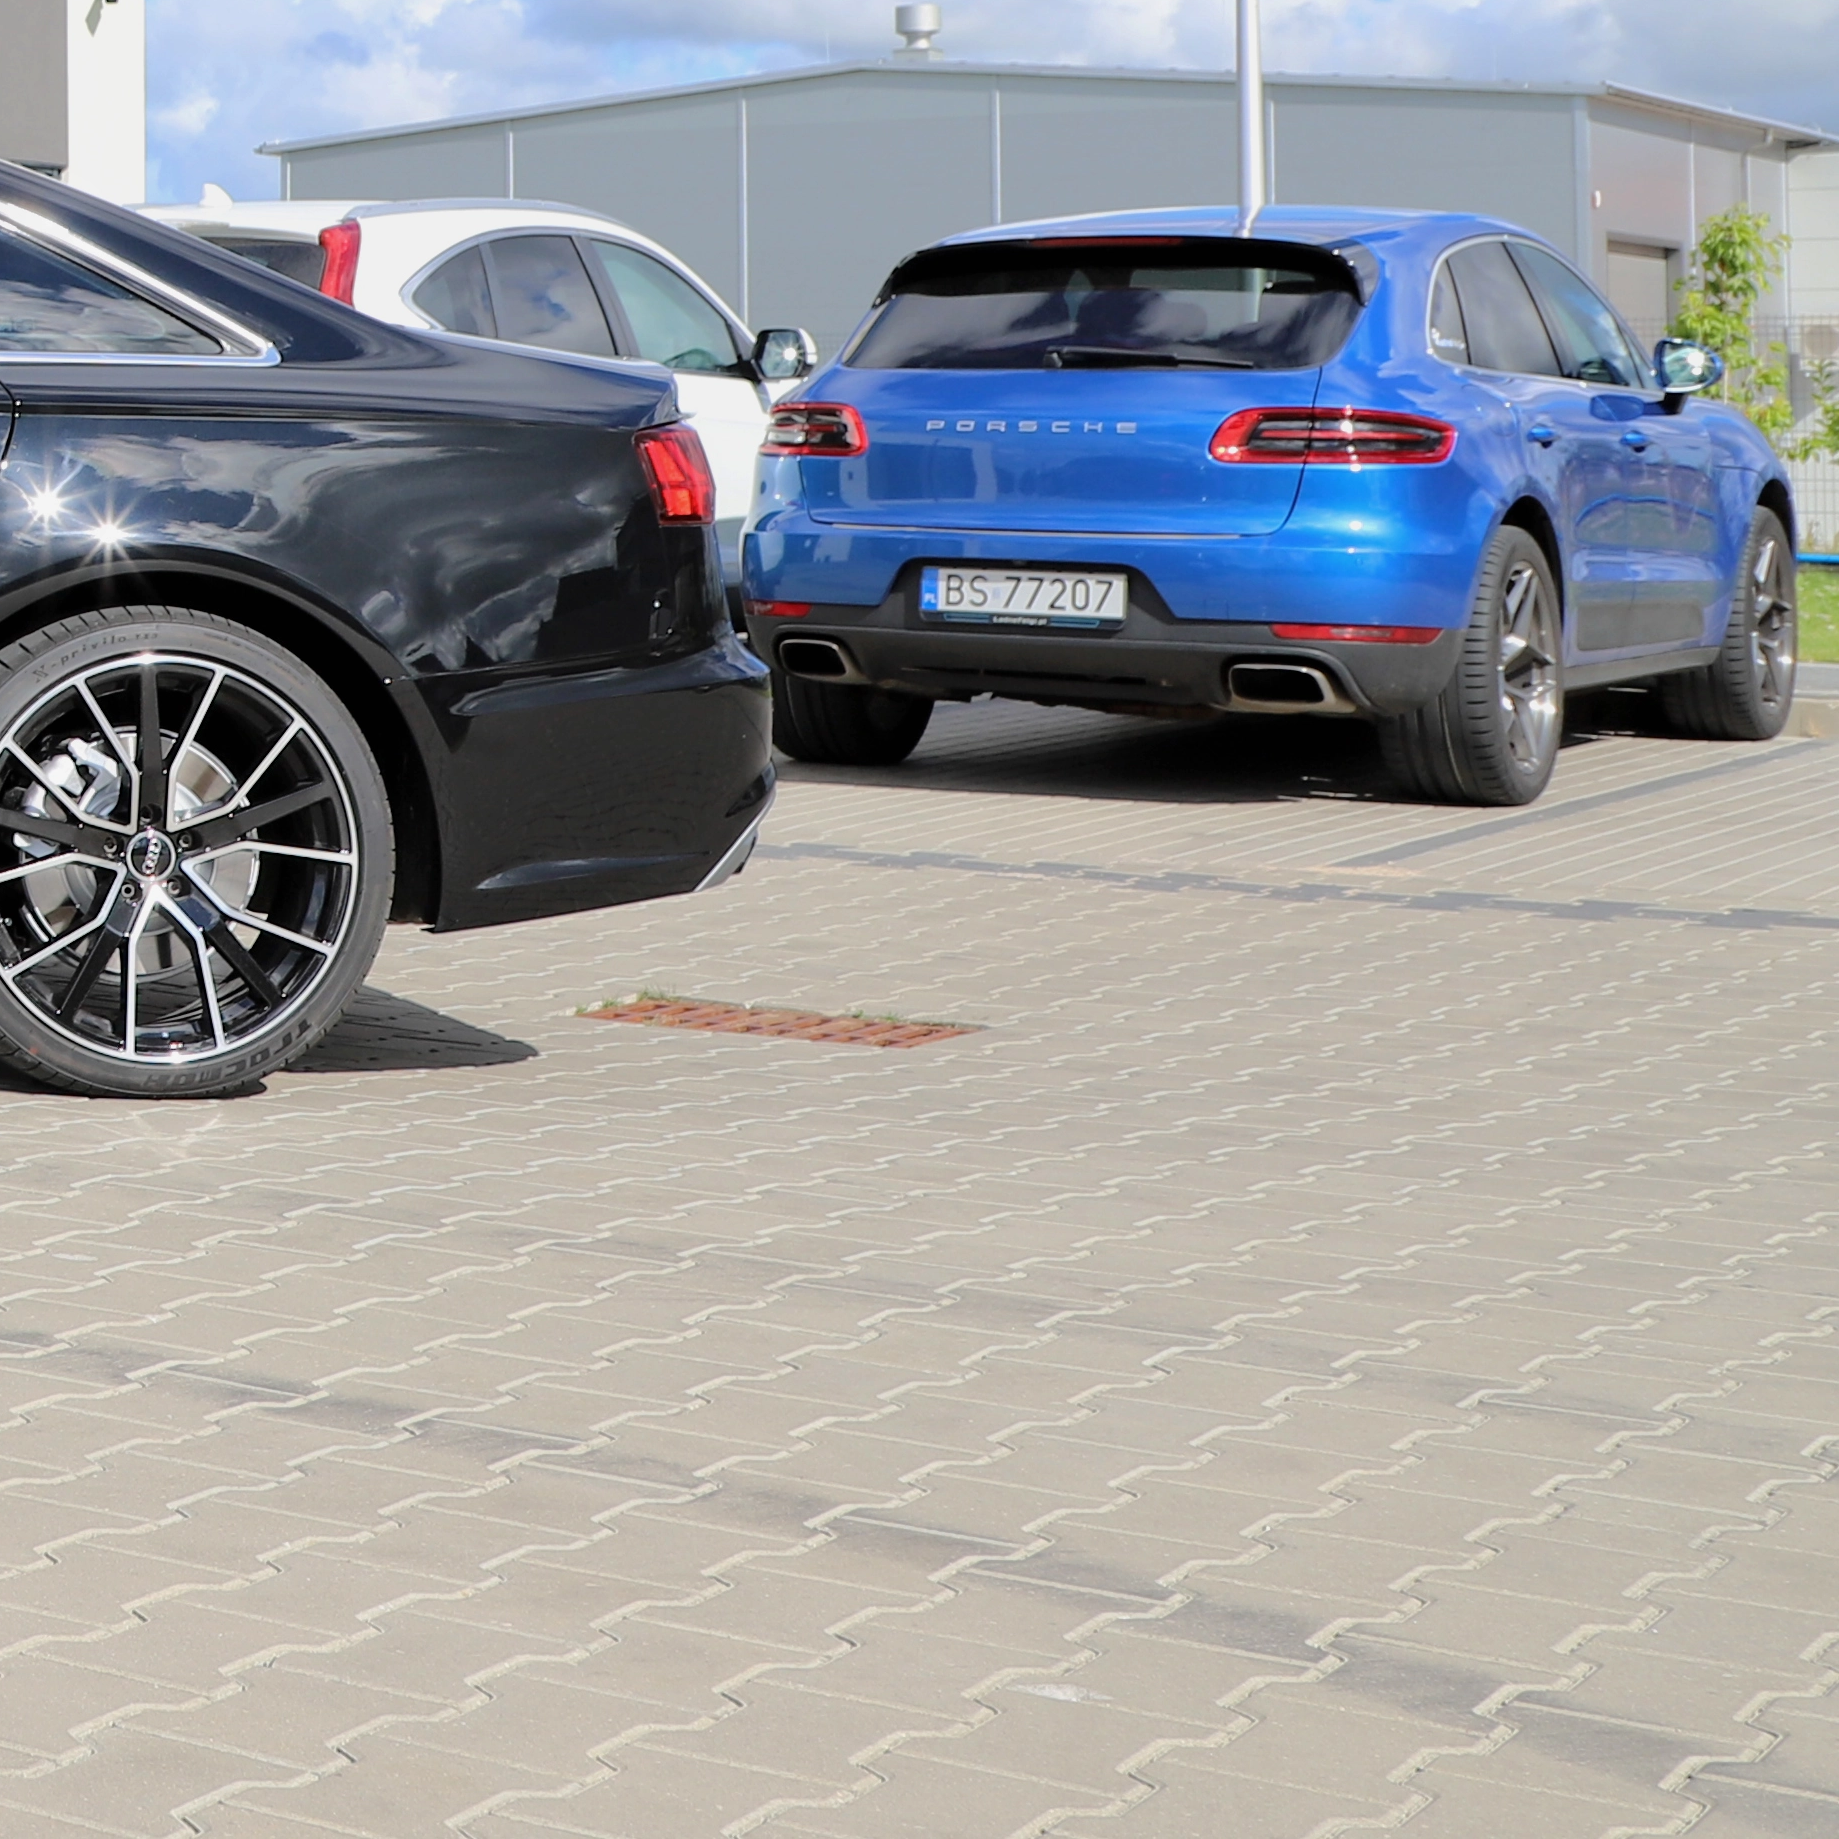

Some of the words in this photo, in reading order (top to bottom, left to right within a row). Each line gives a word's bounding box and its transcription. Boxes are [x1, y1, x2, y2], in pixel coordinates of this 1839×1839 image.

[926, 419, 1137, 434] PORSCHE
[924, 593, 937, 604] PL
[945, 574, 988, 607] BS
[1003, 576, 1113, 613] 77207
[32, 635, 127, 684] X-privilo
